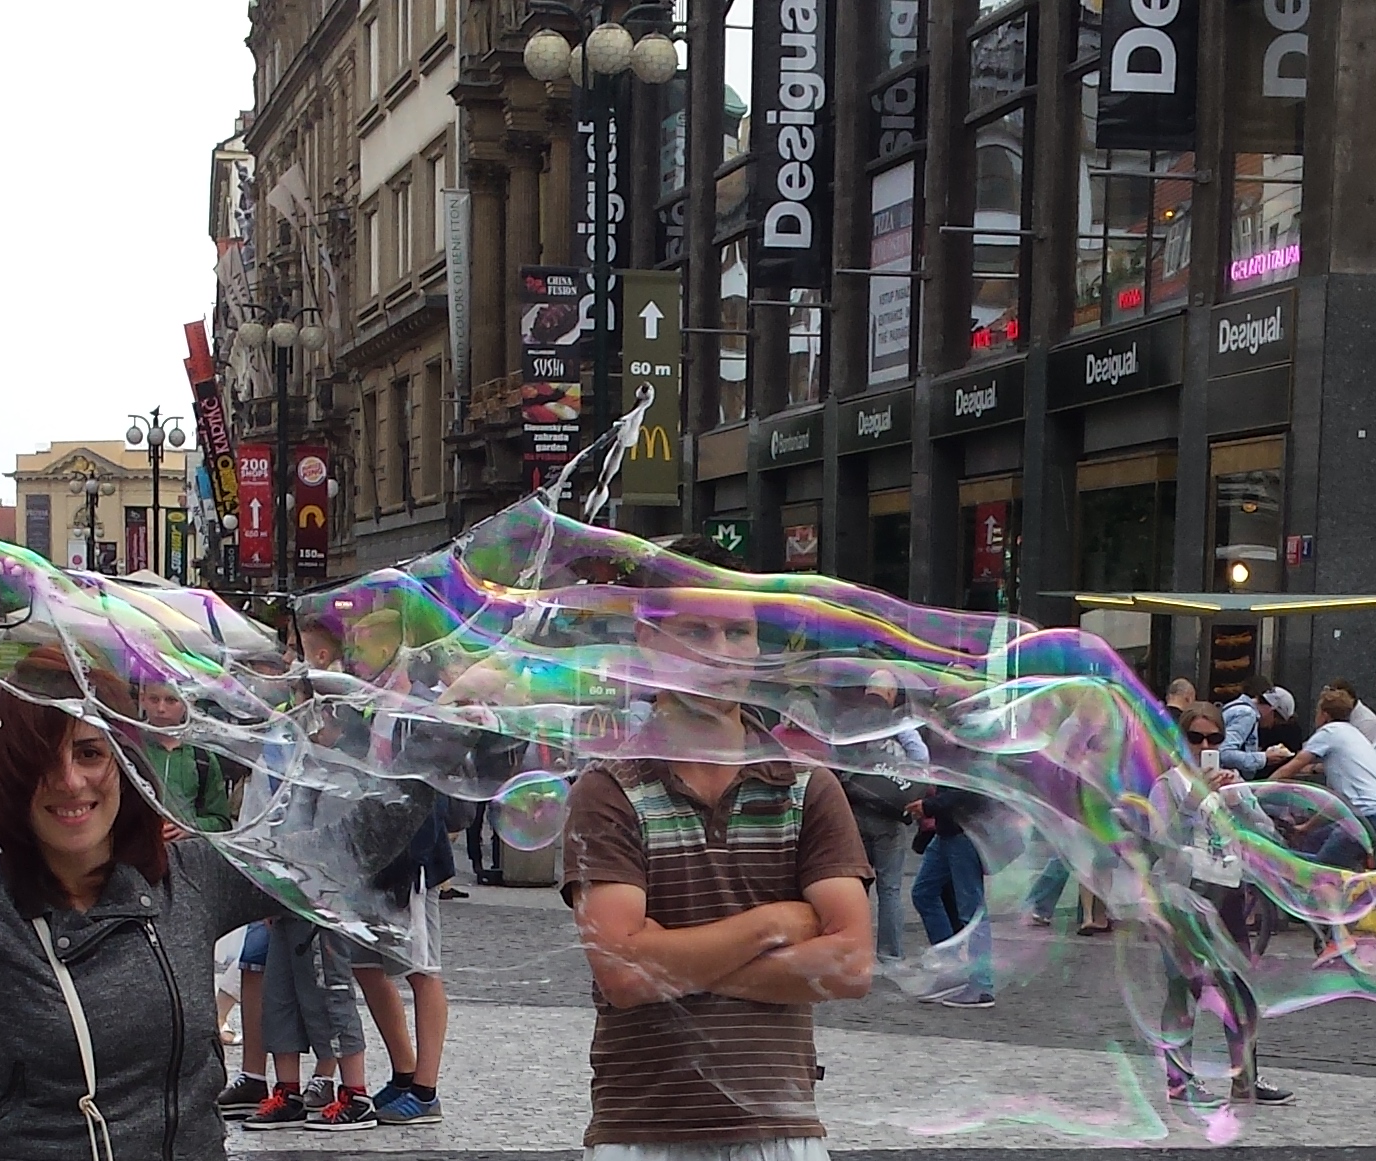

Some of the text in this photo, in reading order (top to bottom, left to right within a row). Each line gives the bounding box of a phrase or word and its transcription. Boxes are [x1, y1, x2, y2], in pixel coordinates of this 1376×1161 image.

[546, 275, 573, 286] CHINA
[547, 285, 578, 296] FUSION
[1218, 305, 1283, 355] Desigual
[630, 361, 672, 376] 60 m
[1085, 341, 1138, 385] Desigual
[955, 380, 997, 418] Desigual
[857, 405, 892, 438] Desigual
[240, 458, 268, 470] 200
[170, 525, 183, 573] SUBWAY
